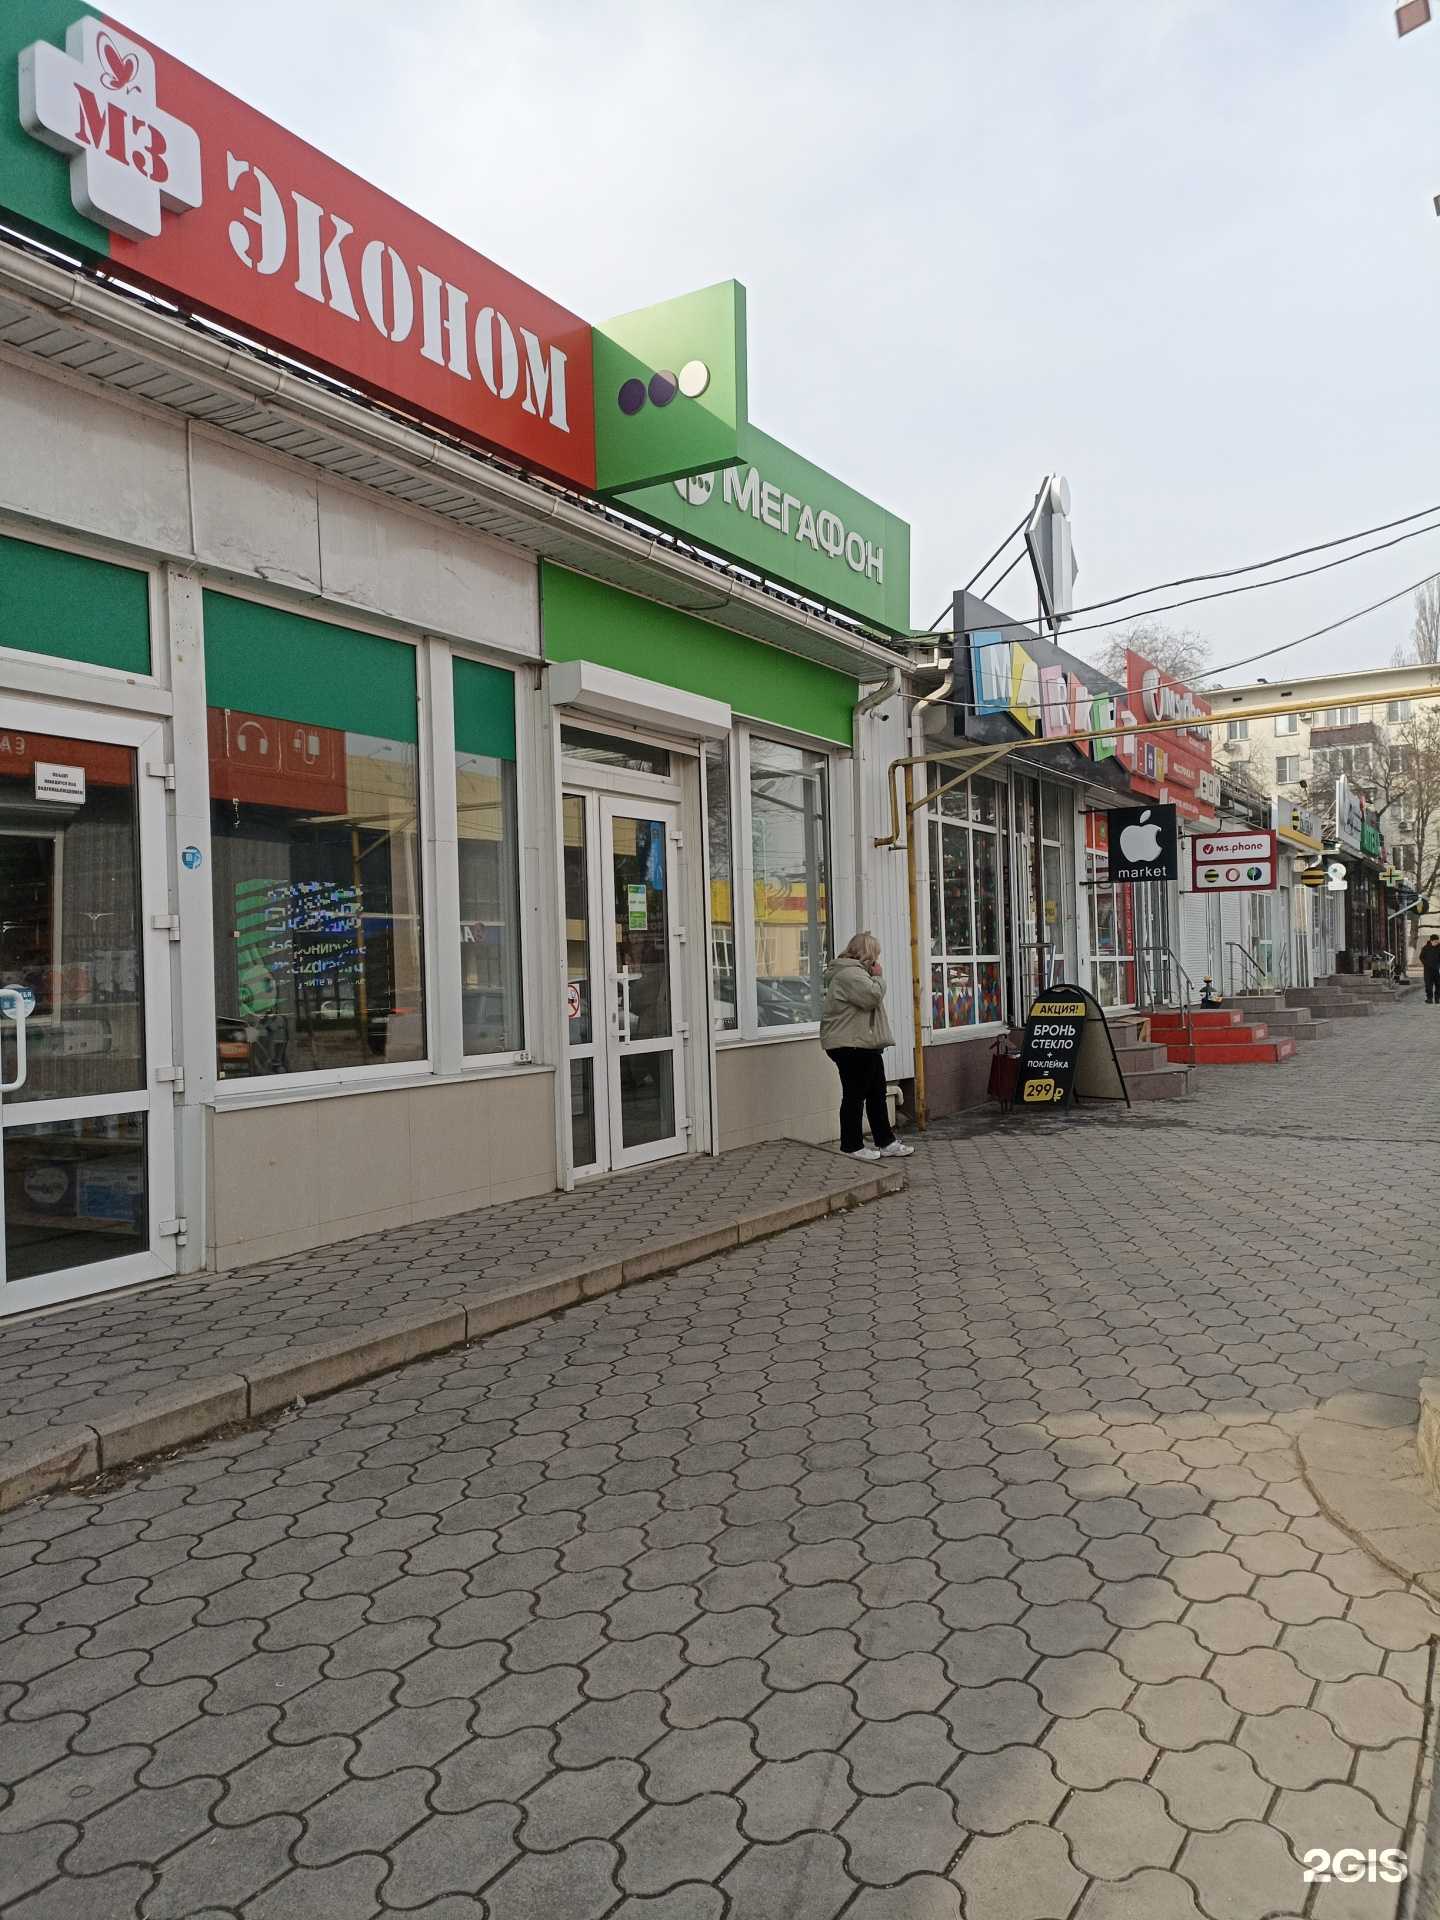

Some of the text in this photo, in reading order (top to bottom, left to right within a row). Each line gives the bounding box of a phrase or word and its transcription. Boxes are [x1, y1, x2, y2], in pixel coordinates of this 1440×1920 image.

[226, 150, 571, 433] ЭКОНОМ
[723, 466, 884, 584] МЕГАФОН
[1118, 865, 1167, 879] market
[1039, 1004, 1079, 1015] АКЦИЯ!
[1033, 1024, 1076, 1037] БРОНЬ
[1031, 1039, 1074, 1050] СТЕКЛО
[1027, 1060, 1069, 1069] ПОКЛЕЙКА
